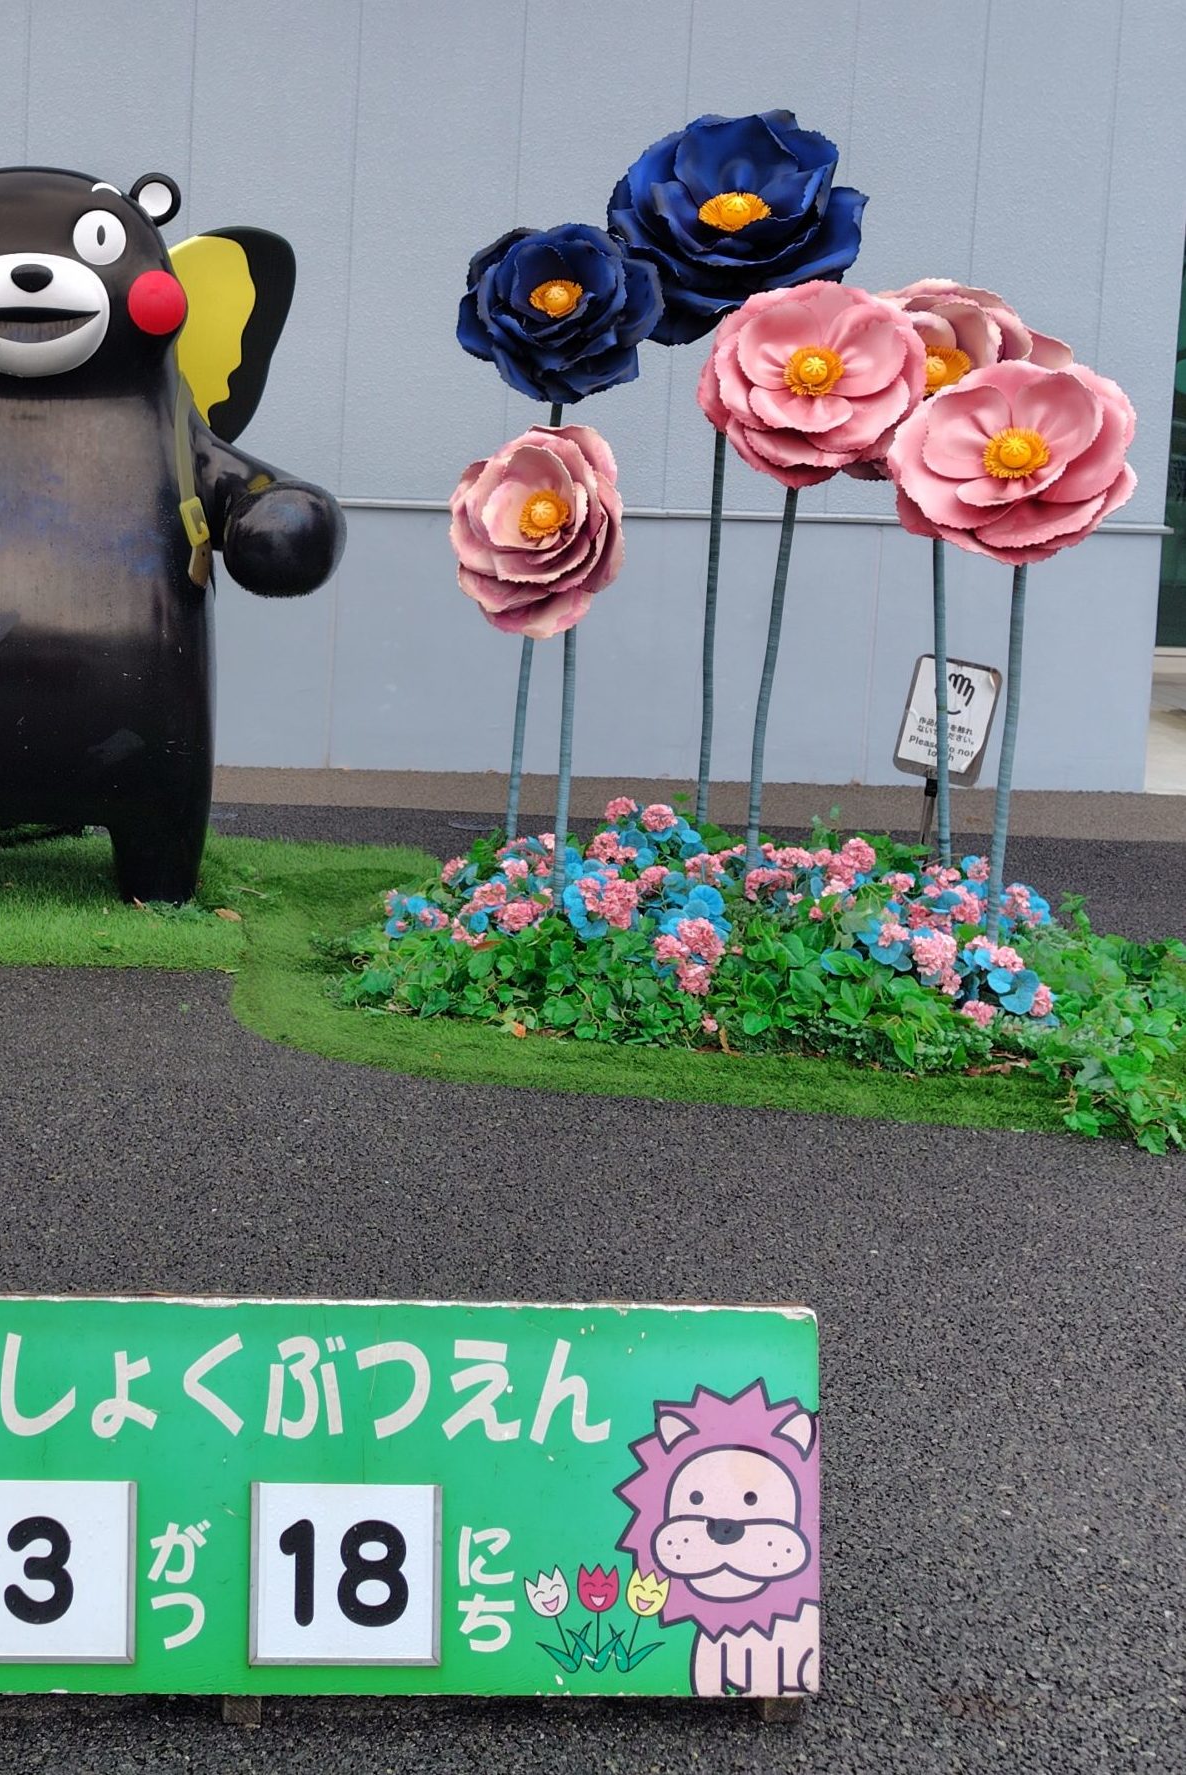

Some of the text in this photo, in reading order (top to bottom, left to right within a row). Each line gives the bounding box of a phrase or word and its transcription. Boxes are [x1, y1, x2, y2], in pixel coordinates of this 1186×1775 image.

[919, 716, 973, 735] 作品を触れ
[927, 749, 955, 762] toh
[958, 749, 975, 758] not
[4, 1516, 74, 1625] 3
[148, 1519, 212, 1650] がつ
[279, 1519, 409, 1627] 18
[458, 1526, 516, 1653] にち
